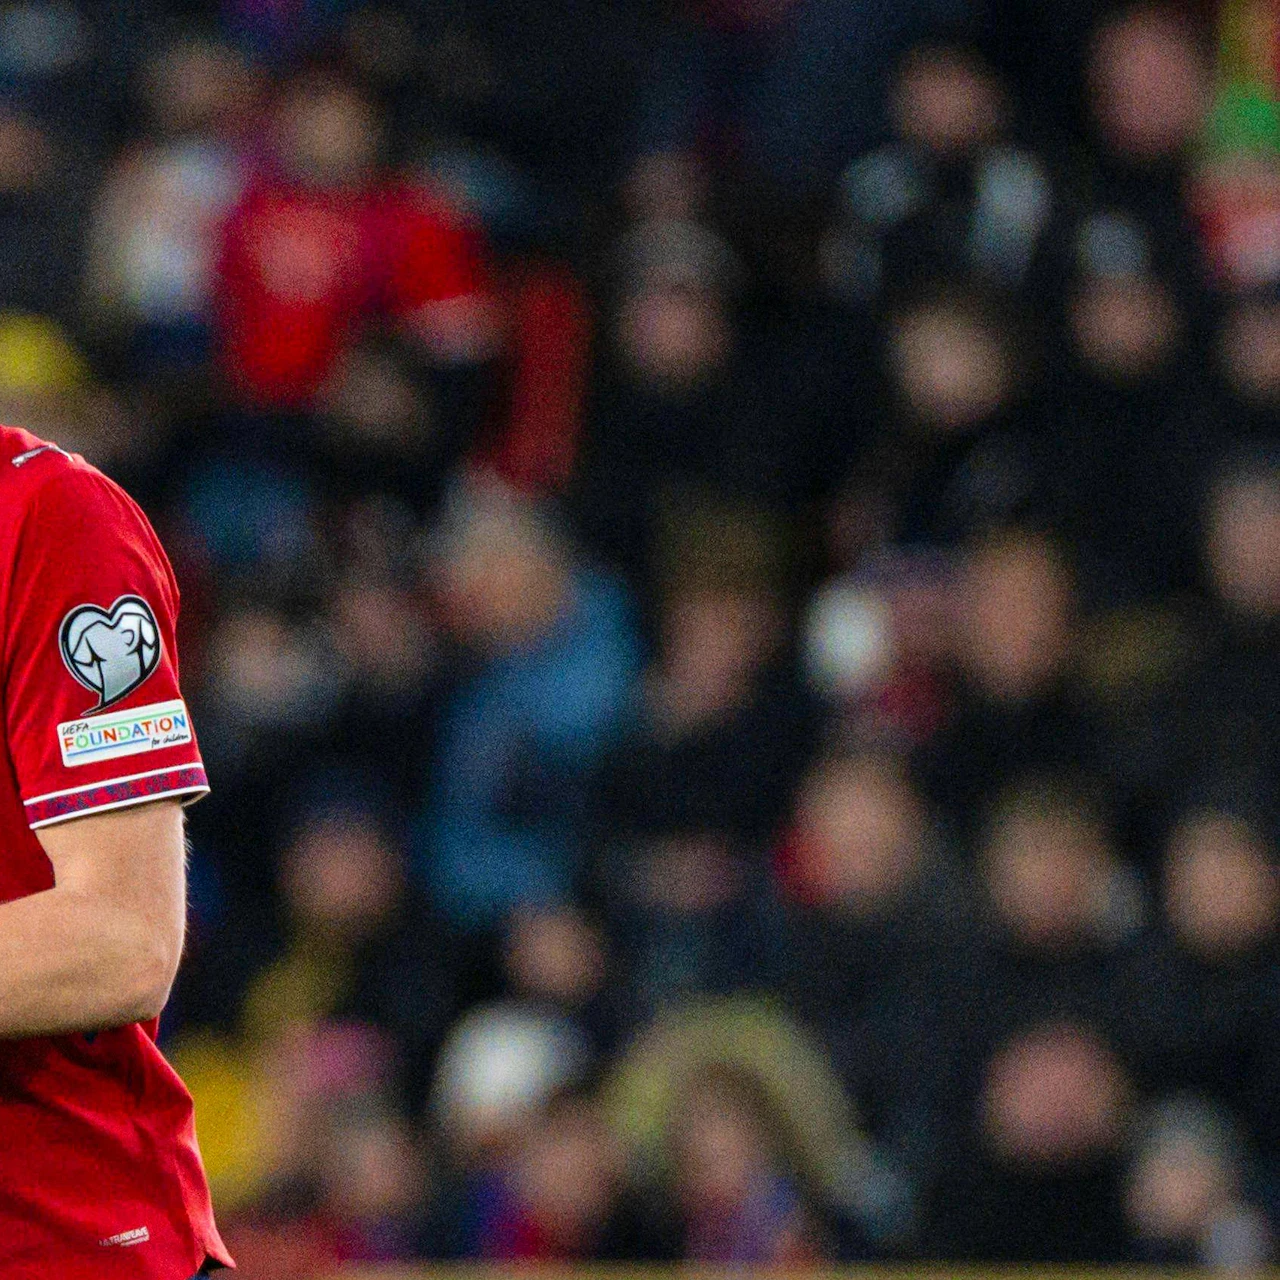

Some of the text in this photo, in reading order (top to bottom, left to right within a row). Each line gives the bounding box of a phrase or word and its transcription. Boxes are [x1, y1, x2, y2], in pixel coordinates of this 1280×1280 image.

[62, 722, 90, 736] UEFA
[64, 713, 187, 752] FOUNDATION
[151, 733, 189, 748] for children
